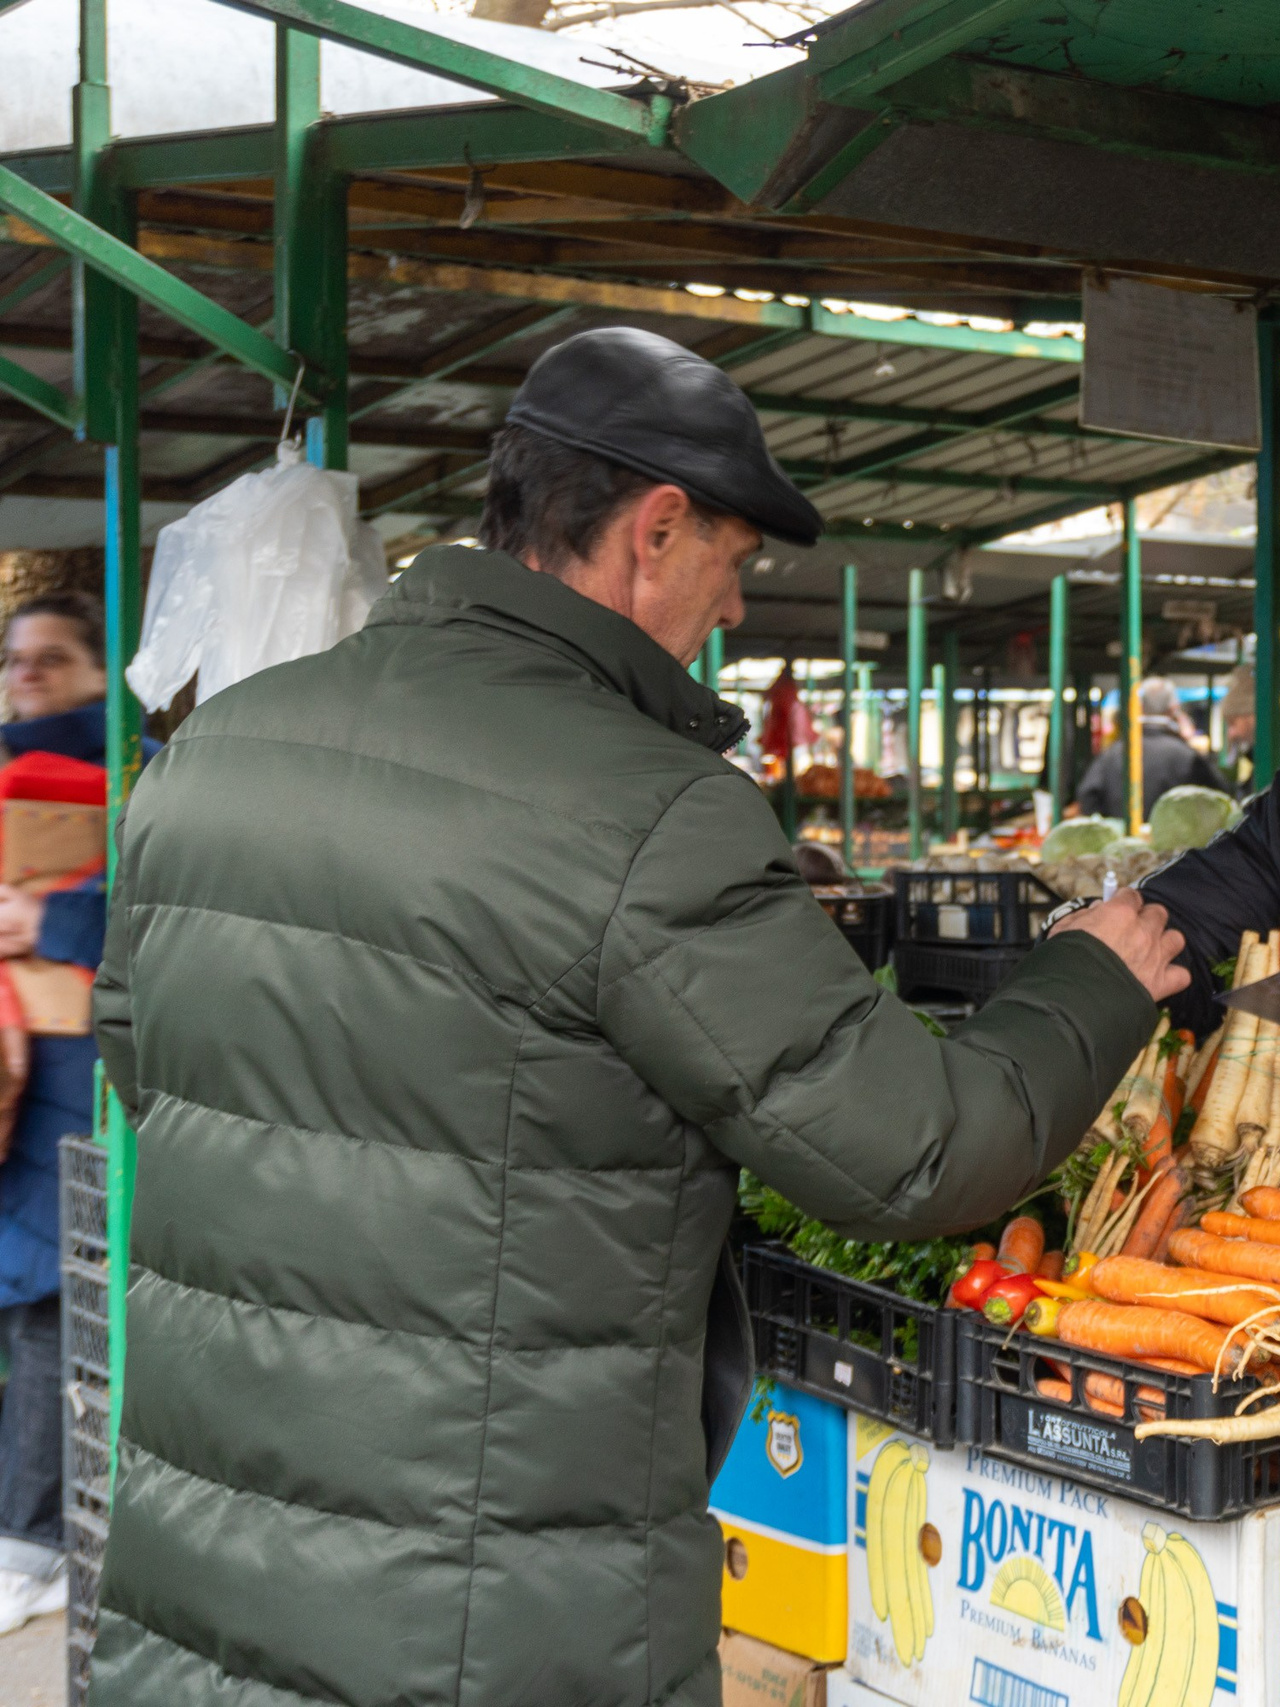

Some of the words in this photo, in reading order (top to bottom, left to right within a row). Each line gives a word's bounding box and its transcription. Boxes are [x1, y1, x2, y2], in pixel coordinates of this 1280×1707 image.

[967, 1447, 1051, 1500] PREMIUM
[1059, 1478, 1109, 1519] PACK
[957, 1487, 1103, 1642] BONITA
[960, 1598, 1021, 1641] PREMIUM
[1031, 1627, 1097, 1671] BANANAS
